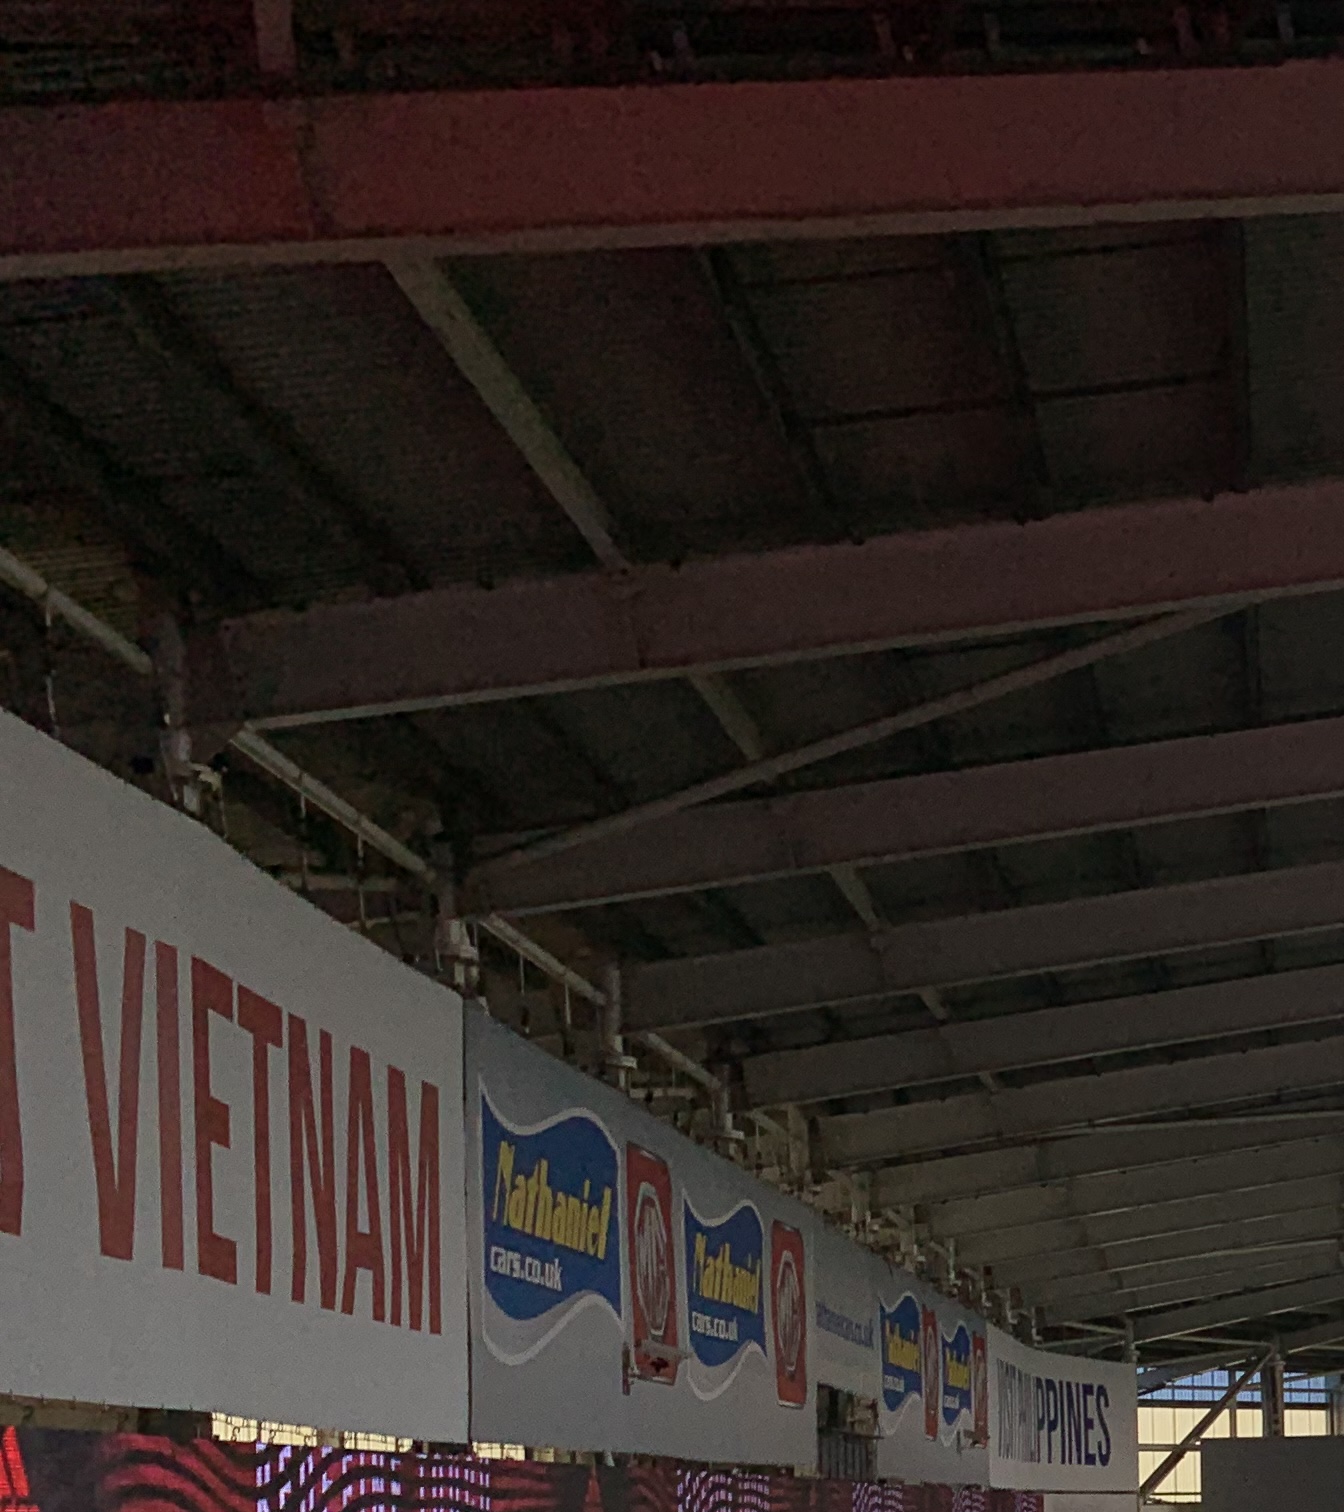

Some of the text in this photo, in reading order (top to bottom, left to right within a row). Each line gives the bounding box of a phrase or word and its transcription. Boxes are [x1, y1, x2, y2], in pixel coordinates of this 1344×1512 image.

[69, 900, 442, 1336] VIETNAM
[493, 1141, 611, 1259] Nathaniel
[490, 1246, 563, 1291] cars.co.uk
[694, 1232, 761, 1314] Nathaniel
